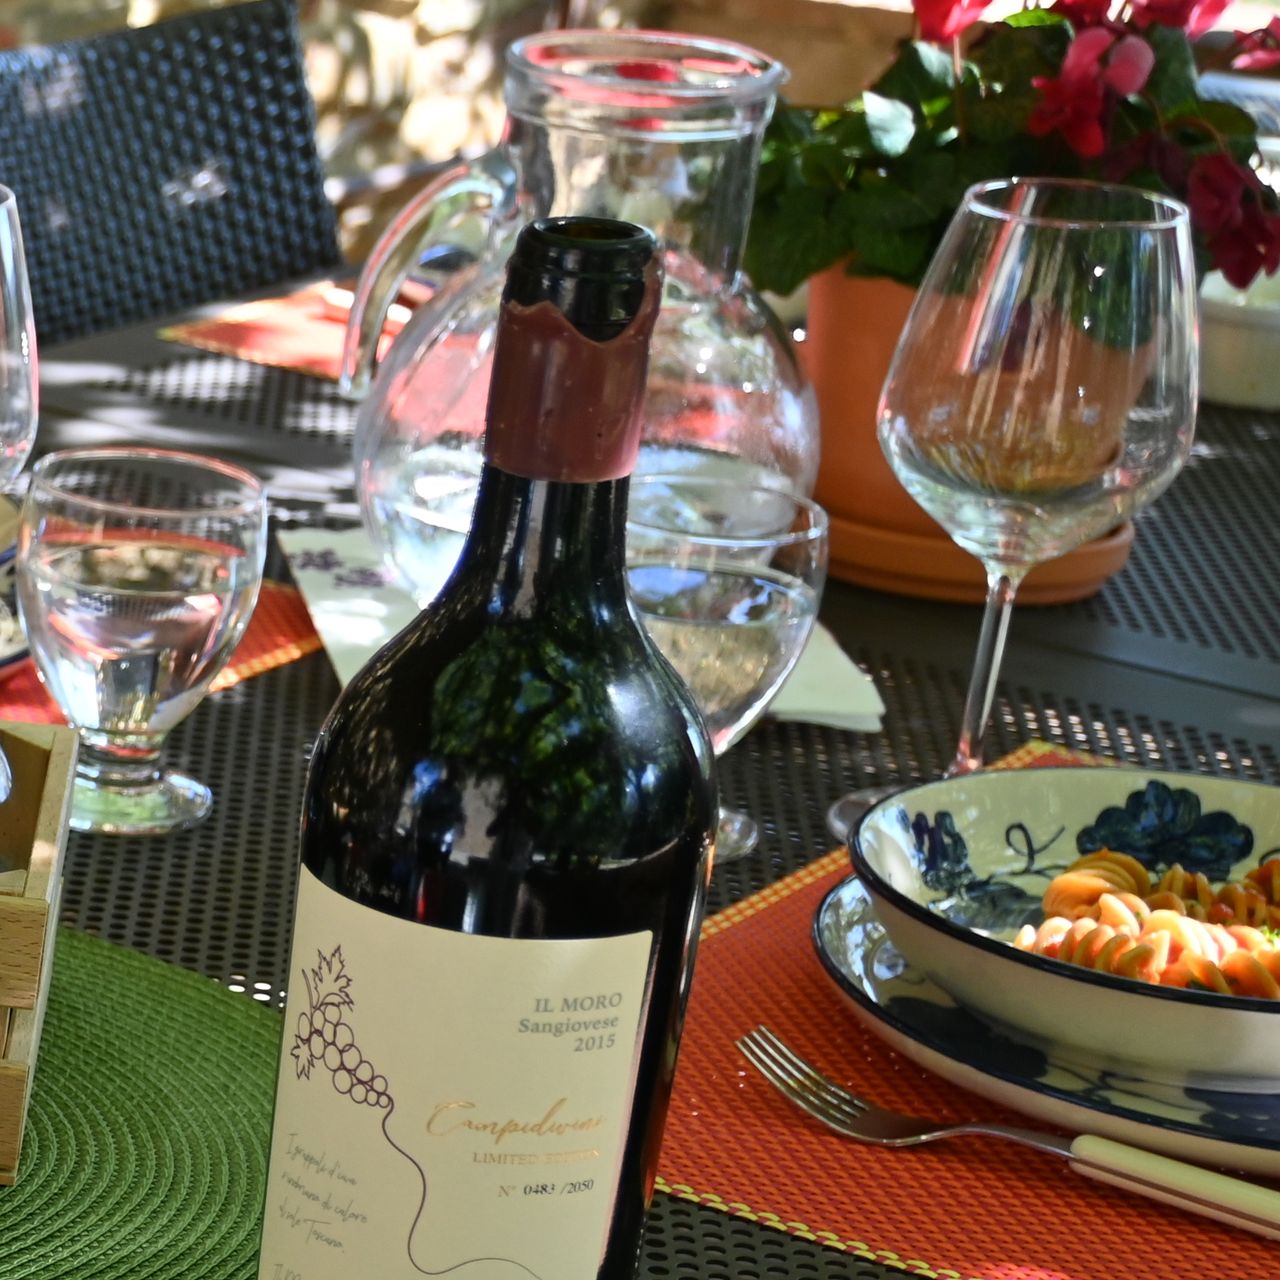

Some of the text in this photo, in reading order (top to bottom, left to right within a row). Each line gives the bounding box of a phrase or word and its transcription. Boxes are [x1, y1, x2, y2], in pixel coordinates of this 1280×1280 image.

[534, 992, 623, 1013] IL MORO
[518, 1016, 619, 1038] Sangiovese
[573, 1033, 616, 1052] 2015
[523, 1182, 557, 1196] 0483
